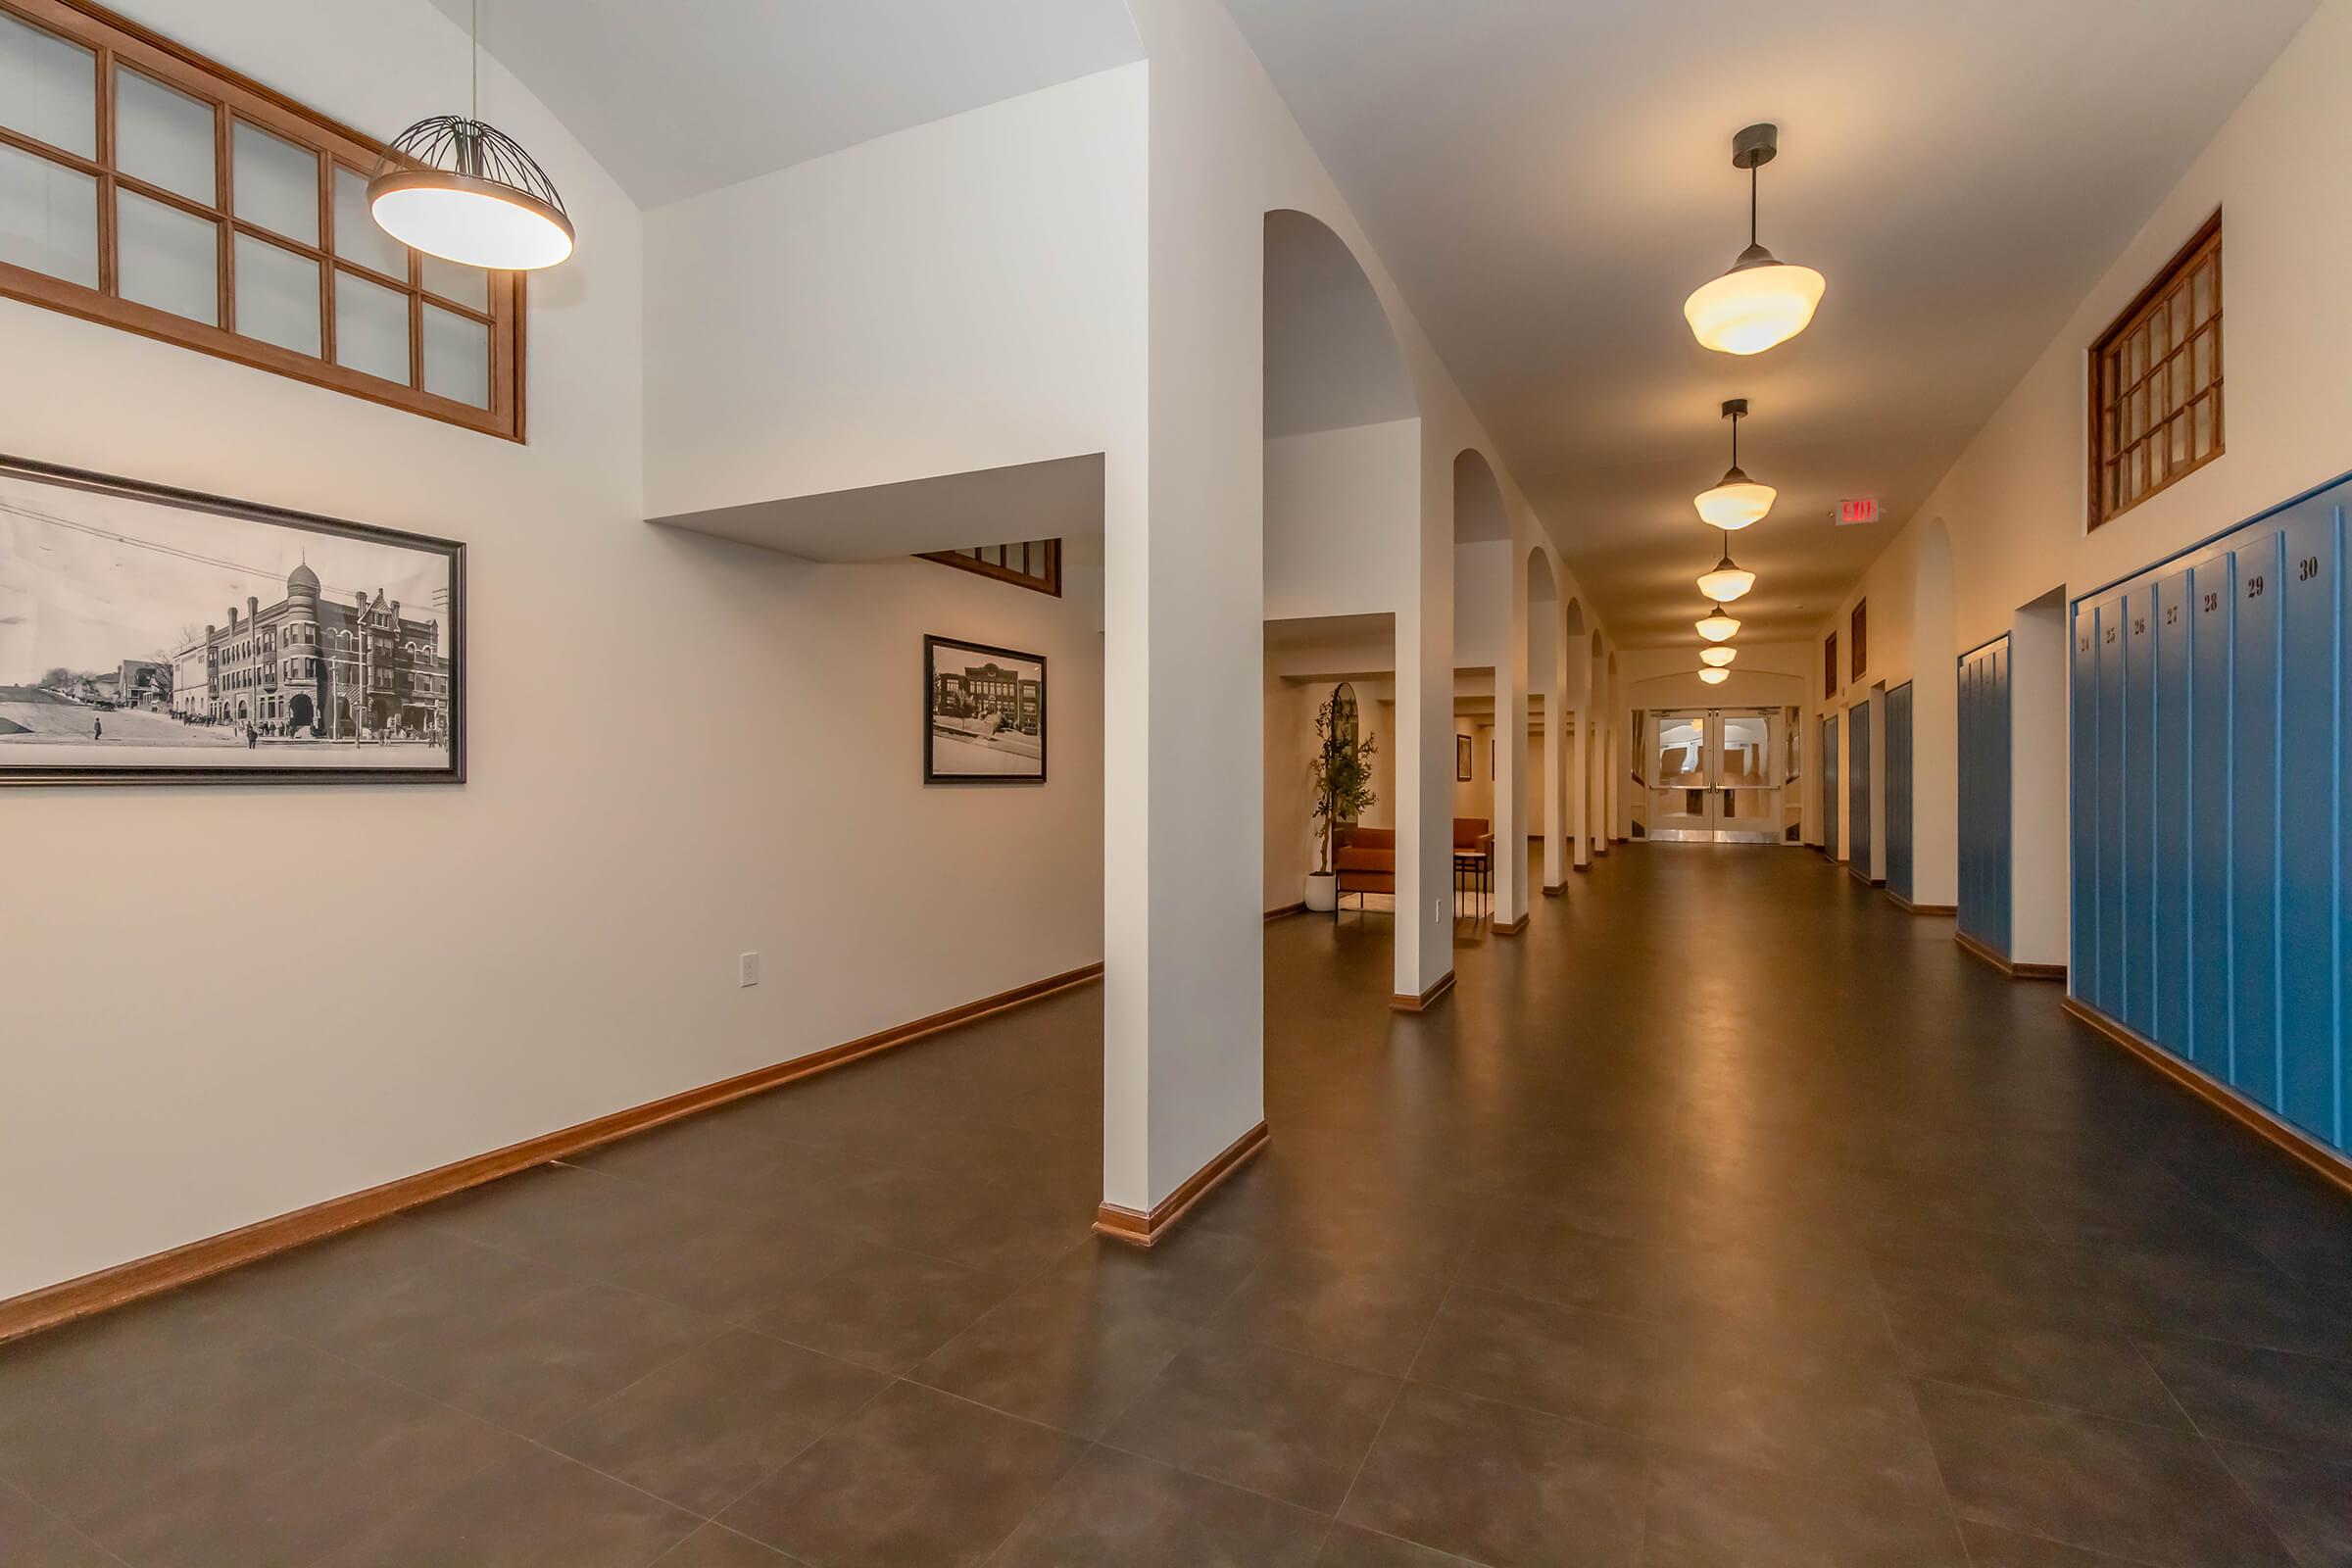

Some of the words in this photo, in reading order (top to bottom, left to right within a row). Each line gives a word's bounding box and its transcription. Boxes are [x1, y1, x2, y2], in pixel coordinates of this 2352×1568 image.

[2300, 556, 2318, 581] 30
[2248, 575, 2264, 598] 29
[2204, 592, 2218, 612] 28
[2167, 606, 2178, 624] 27
[2134, 617, 2145, 635] 26
